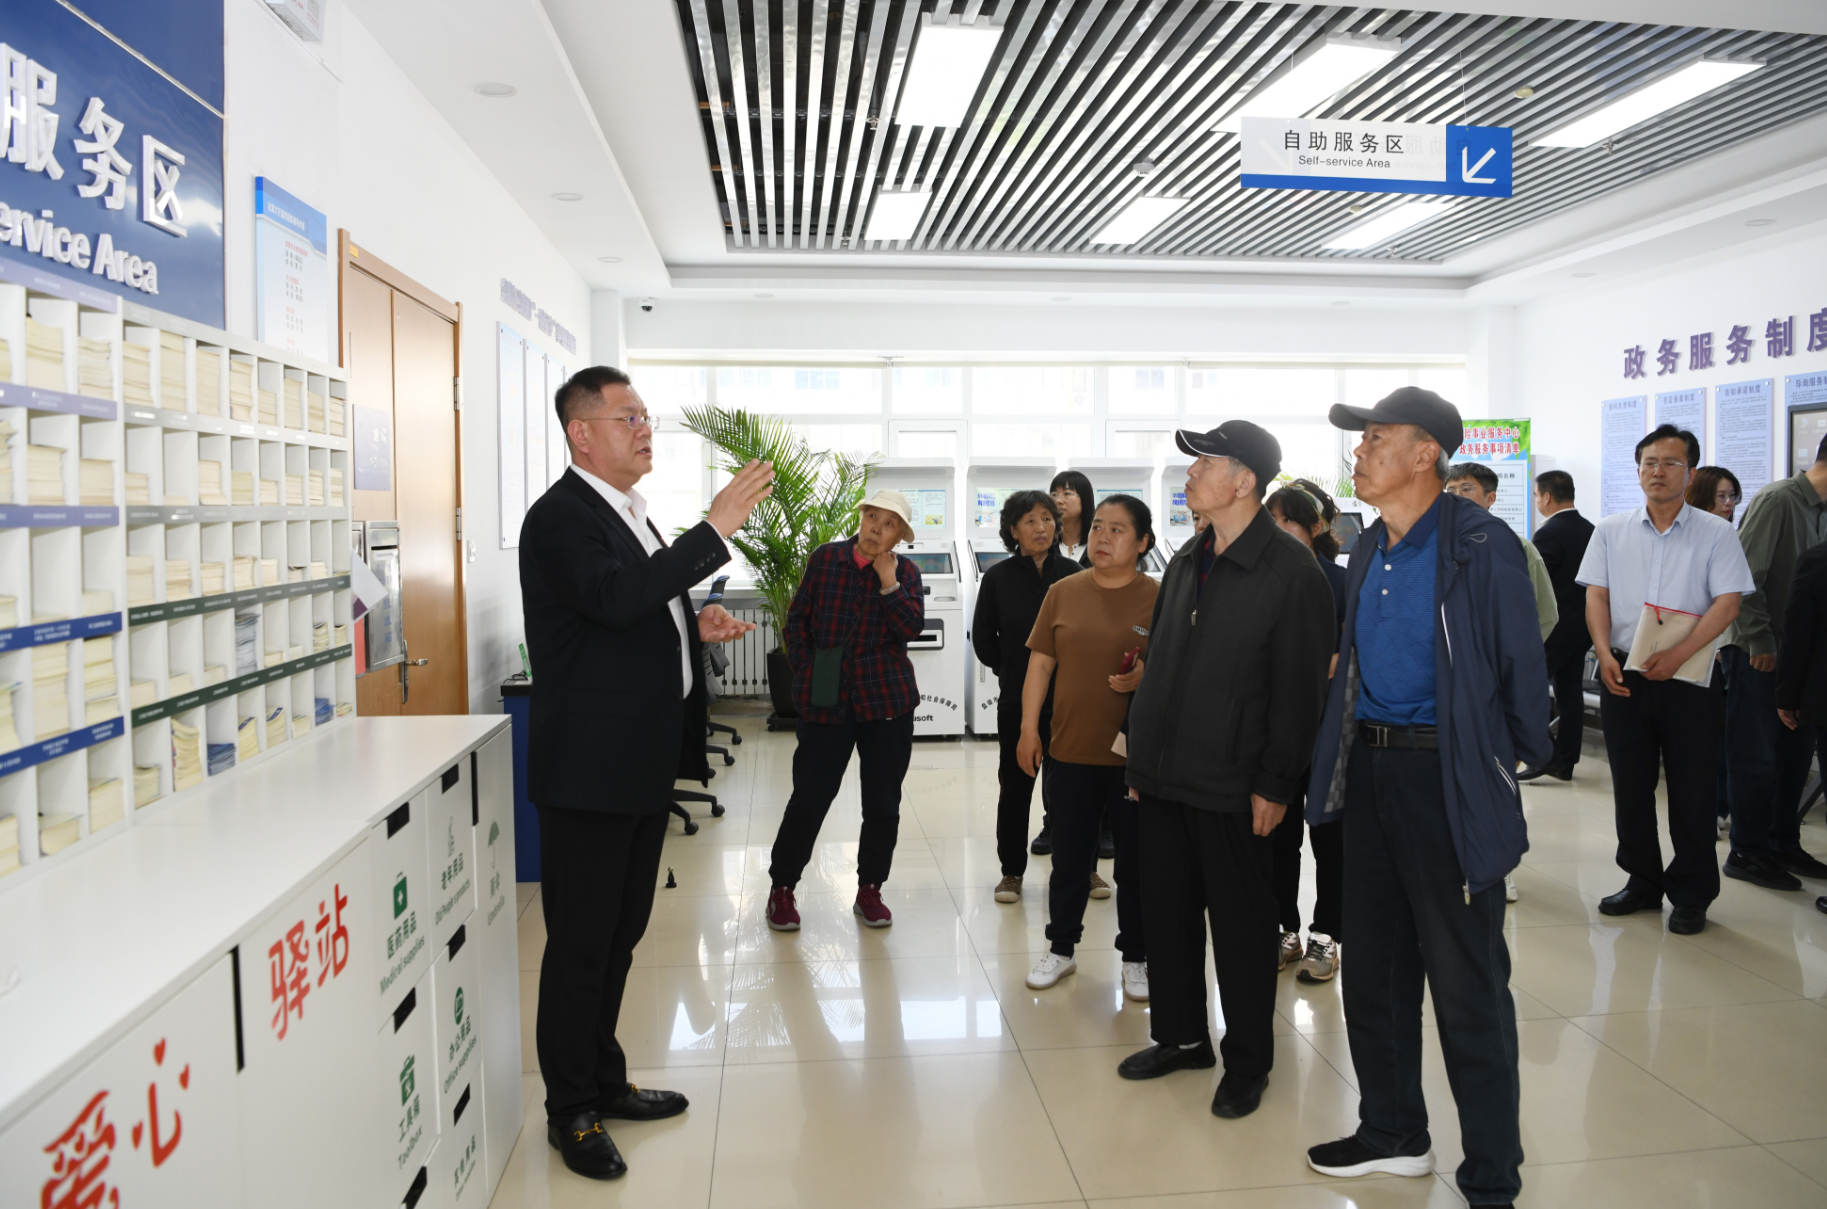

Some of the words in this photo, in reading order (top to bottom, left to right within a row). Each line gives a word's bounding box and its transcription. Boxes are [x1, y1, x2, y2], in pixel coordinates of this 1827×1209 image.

[0, 42, 187, 238] 服务区
[1284, 130, 1404, 154] 自助服务区
[1298, 155, 1363, 167] Self-service
[1366, 158, 1391, 168] Area
[92, 233, 159, 295] Area
[1624, 307, 1827, 380] 政务服务制度
[386, 911, 417, 960] 医药用品
[268, 883, 348, 1042] 驿站
[380, 957, 403, 996] Medical
[399, 1094, 420, 1143] 工具箱
